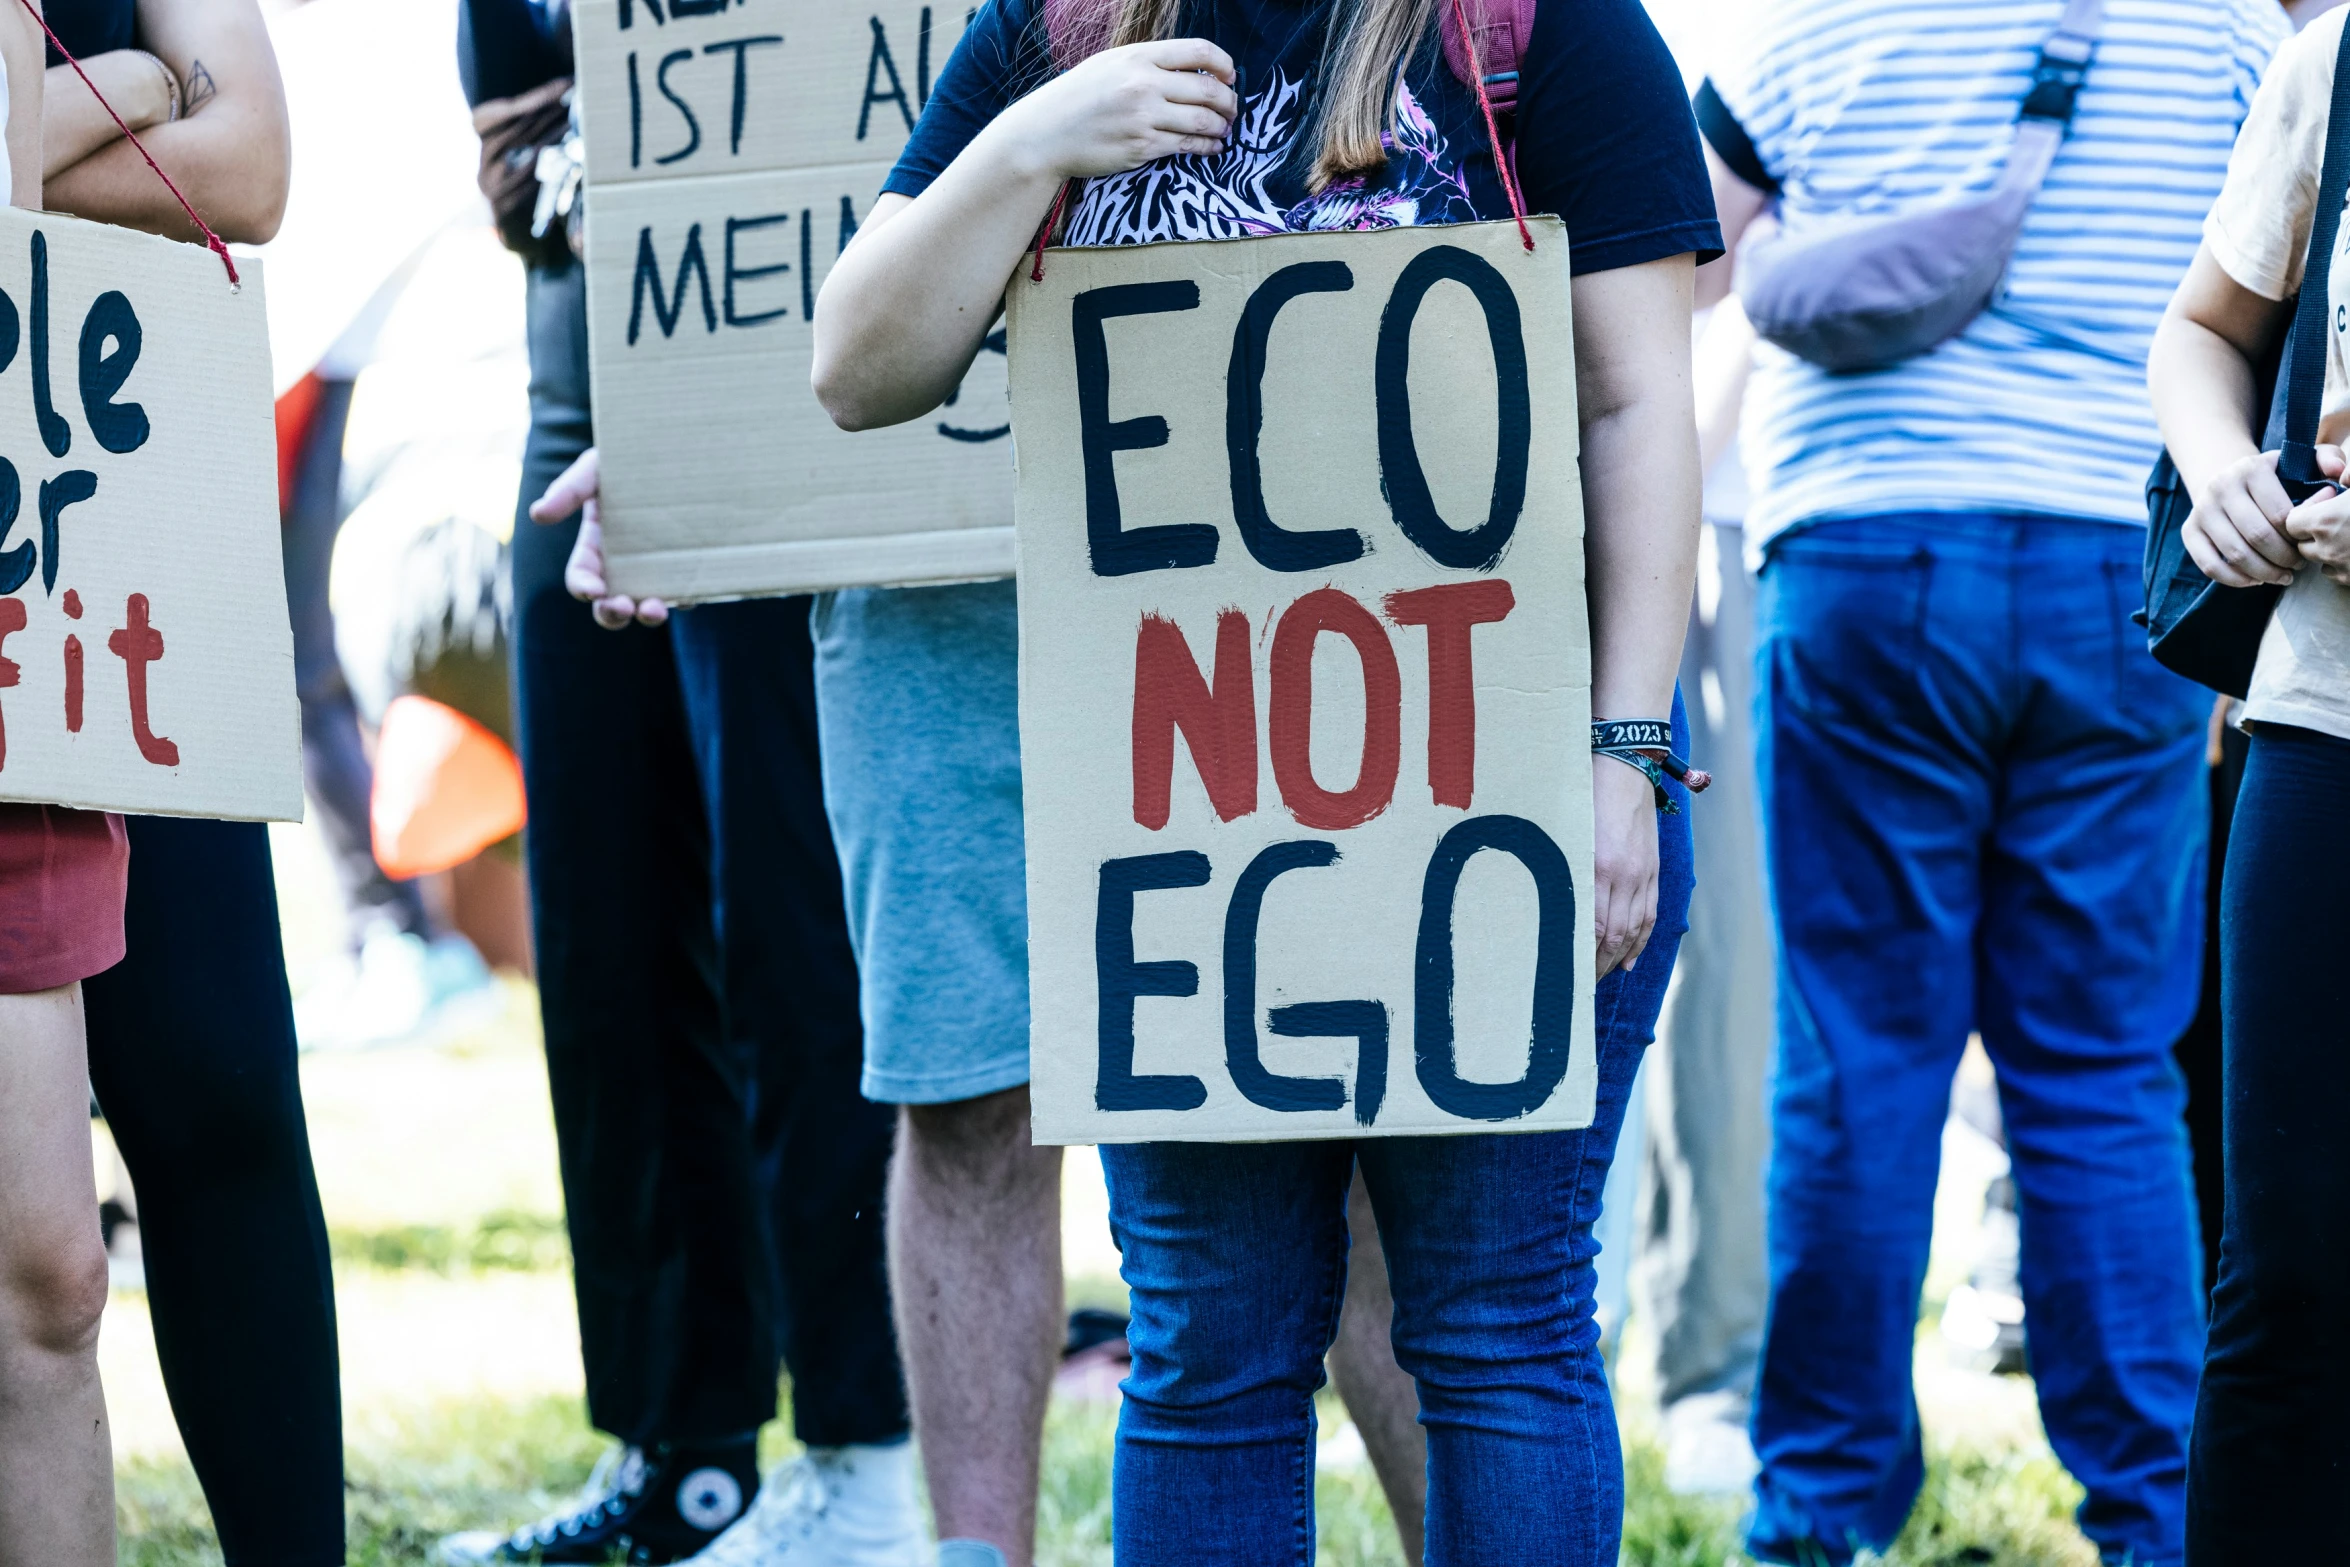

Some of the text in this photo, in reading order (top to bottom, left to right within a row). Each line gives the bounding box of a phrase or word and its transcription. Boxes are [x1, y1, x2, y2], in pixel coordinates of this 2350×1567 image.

[628, 36, 784, 169] IST
[1072, 245, 1531, 576] ECO
[1131, 579, 1516, 831] NOT
[1611, 724, 1661, 743] 2023
[1095, 815, 1576, 1128] EGO
